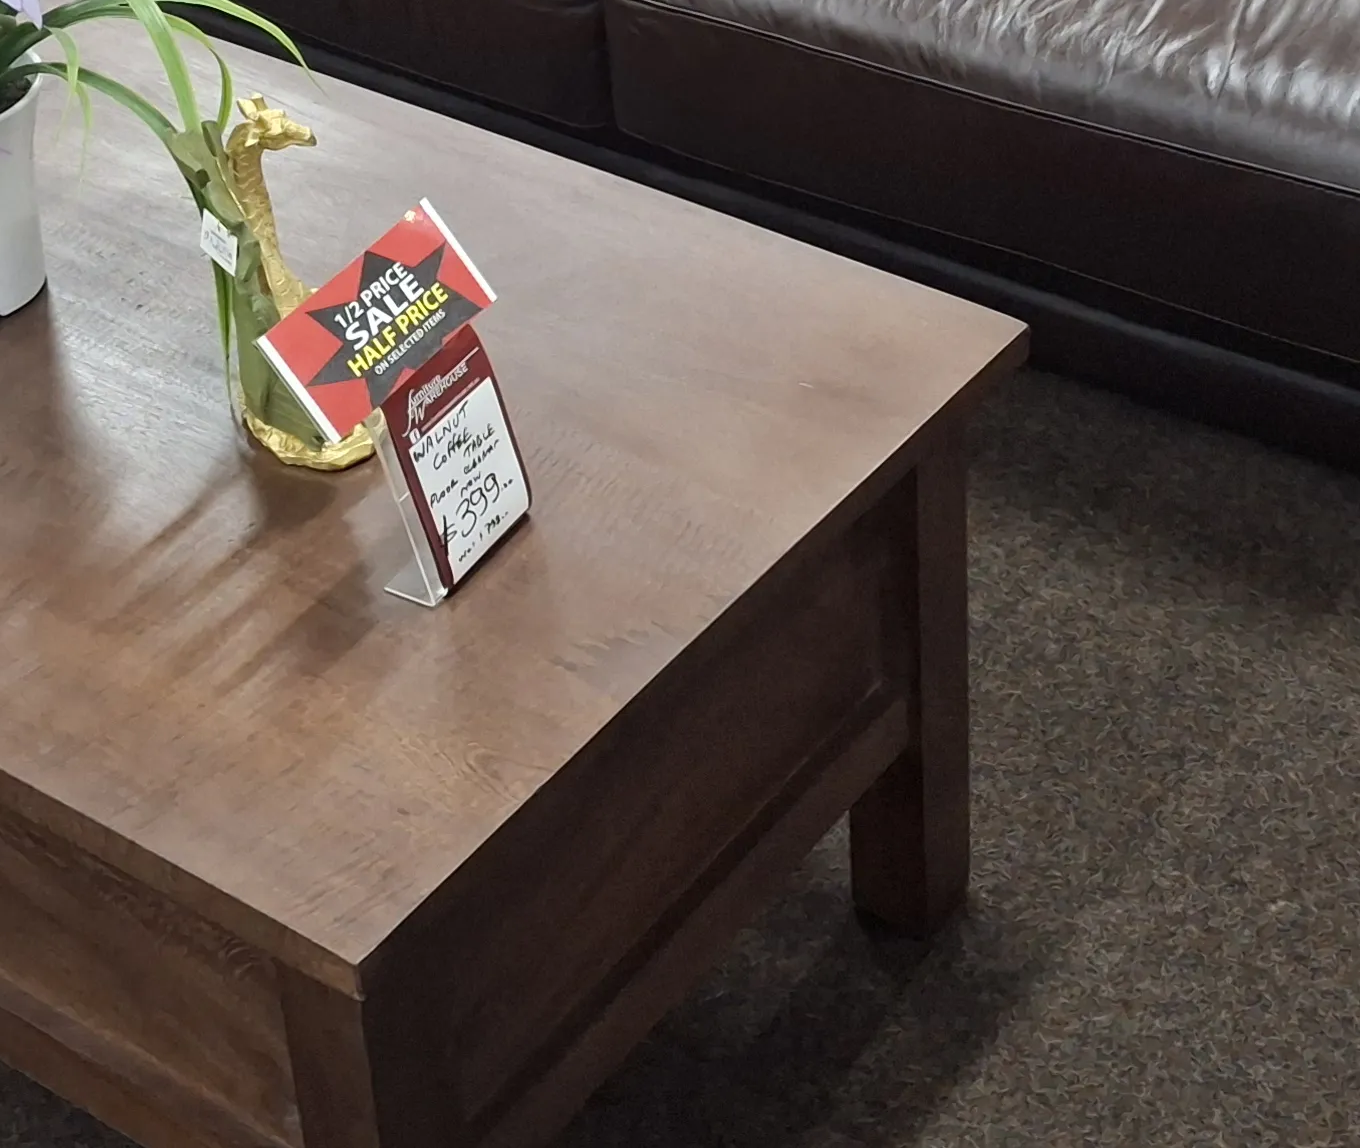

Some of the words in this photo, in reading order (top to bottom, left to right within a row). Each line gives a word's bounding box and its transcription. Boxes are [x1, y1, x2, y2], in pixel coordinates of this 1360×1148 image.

[334, 301, 365, 328] 1/2
[360, 261, 408, 308] PRICE
[345, 273, 425, 351] SALE
[347, 325, 397, 377] HALF
[395, 282, 449, 335] PRICE
[374, 359, 390, 375] ON
[387, 328, 424, 365] SELECTED
[423, 308, 446, 333] ITEMS
[414, 361, 469, 424] WAREHOUSE
[413, 400, 469, 463] WALNUT
[463, 423, 496, 459] TABLE
[460, 471, 482, 498] NOW
